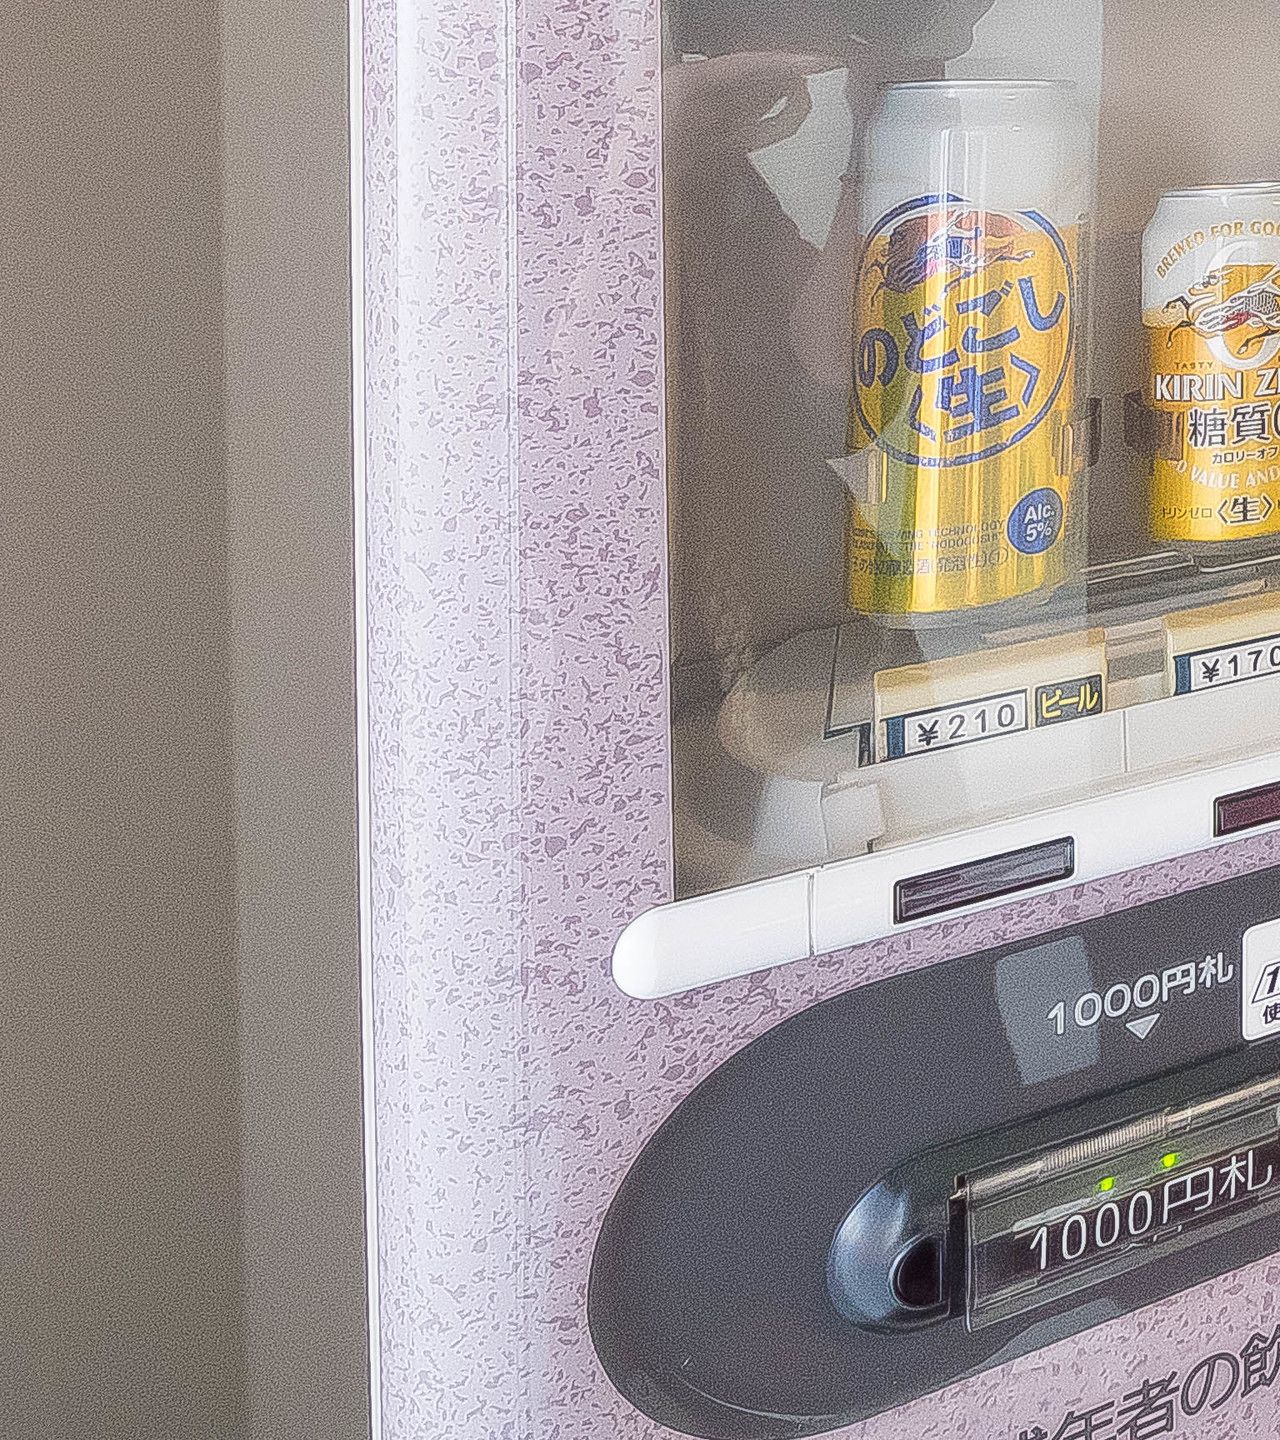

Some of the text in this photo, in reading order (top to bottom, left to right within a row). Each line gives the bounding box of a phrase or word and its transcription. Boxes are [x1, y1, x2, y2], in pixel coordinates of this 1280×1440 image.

[1156, 229, 1205, 278] BREWED
[1210, 221, 1244, 238] FOR
[858, 274, 1066, 390] のどごし
[1155, 371, 1242, 403] KIRIN
[1189, 465, 1242, 491] VALUE
[1246, 464, 1280, 487] AND
[1211, 447, 1278, 466] カロリーオフ
[1024, 503, 1055, 523] Alc.
[1025, 521, 1053, 542] 5%
[916, 683, 1099, 747] ¥210 ビール
[1046, 951, 1235, 1037] 1000円札
[1028, 1149, 1274, 1271] 1000円札
